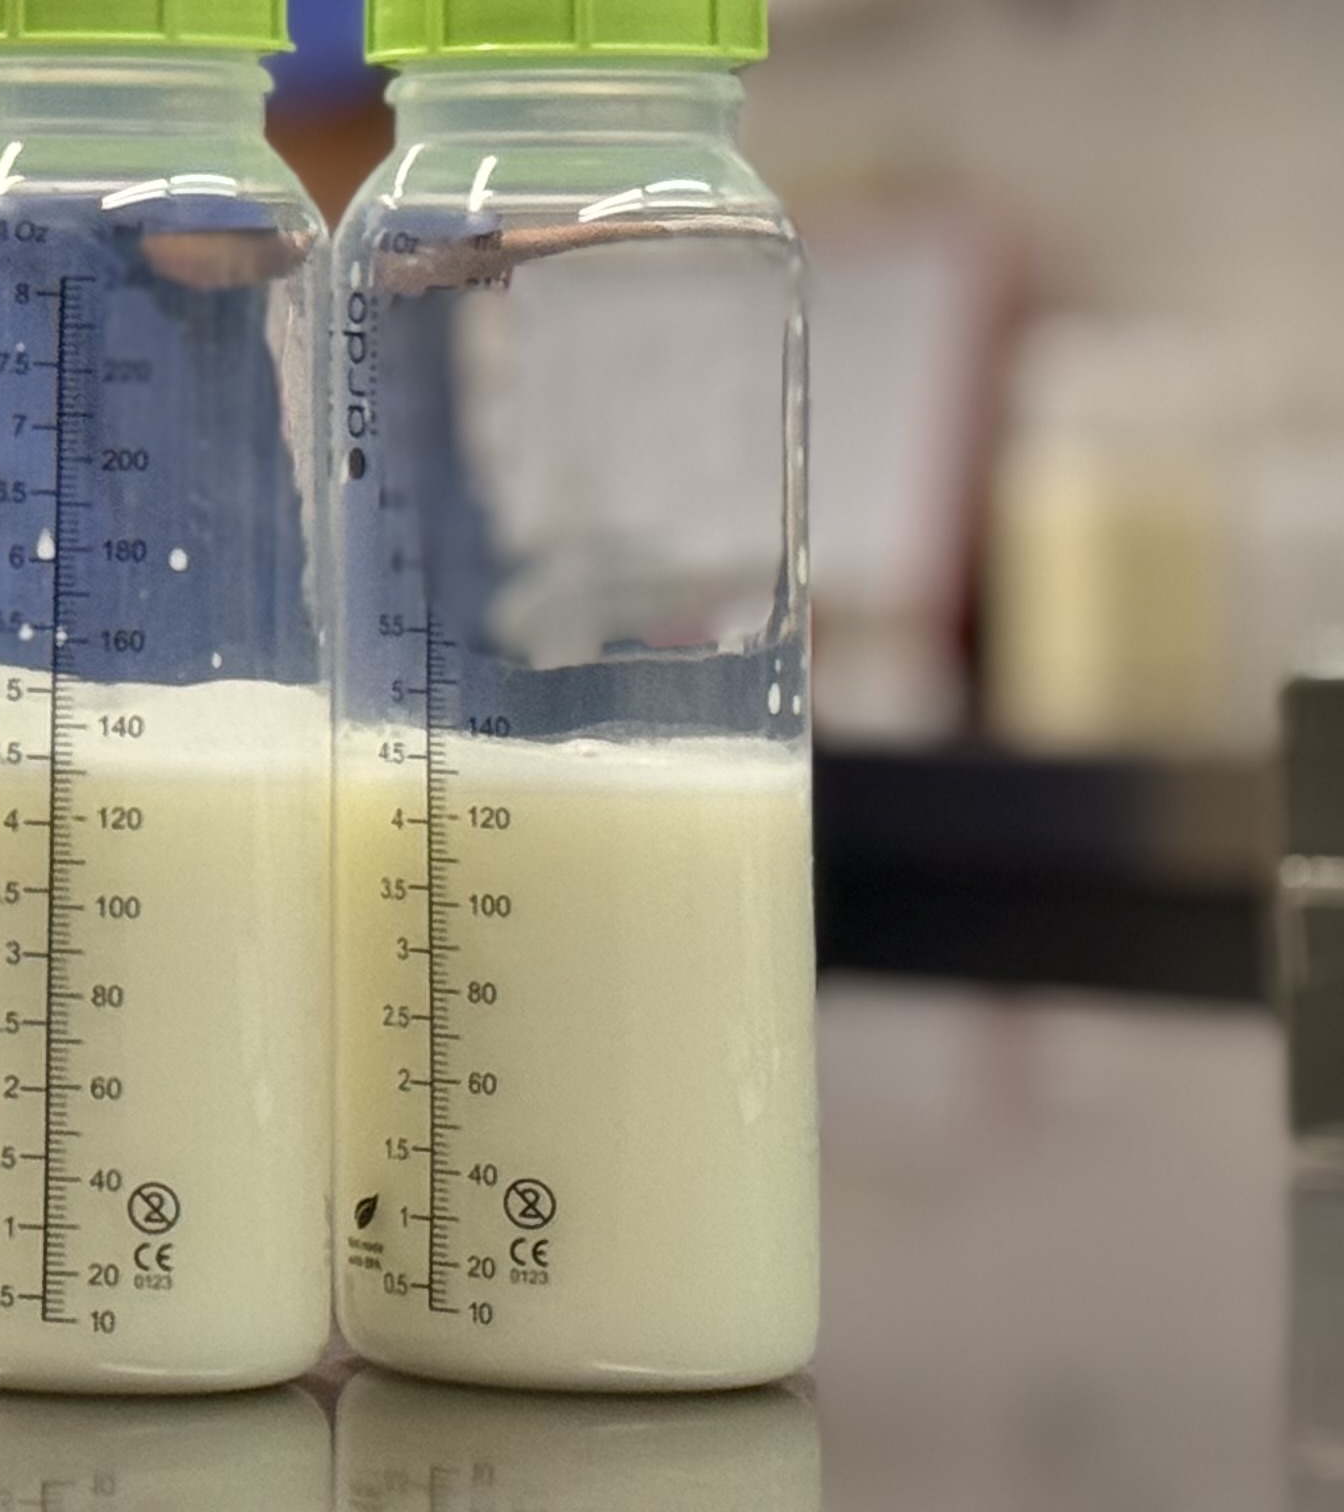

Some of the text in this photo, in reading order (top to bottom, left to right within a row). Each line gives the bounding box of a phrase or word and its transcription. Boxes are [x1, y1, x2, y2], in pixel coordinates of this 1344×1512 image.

[15, 220, 50, 243] Oz
[15, 282, 30, 305] 8
[342, 292, 368, 439] ardo
[11, 415, 27, 437] 7
[101, 449, 150, 472] 200
[8, 549, 24, 568] 6
[104, 541, 147, 563] 180
[100, 631, 145, 654] 160
[5, 679, 23, 700] 5
[392, 681, 404, 702] 5
[98, 715, 145, 738] 140
[468, 716, 511, 739] 140
[378, 743, 405, 764] 4.5
[3, 810, 19, 831] 4
[97, 807, 143, 831] 120
[391, 809, 405, 830] 4
[468, 807, 511, 830] 120
[381, 878, 406, 901] 3.5
[96, 896, 141, 920] 100
[469, 894, 511, 918] 100
[5, 942, 21, 965] 3
[396, 938, 409, 960] 3
[92, 986, 124, 1009] 80
[468, 982, 497, 1005] 80
[383, 1006, 410, 1029] 2.5
[3, 1076, 20, 1099] 2
[90, 1078, 123, 1100] 60
[398, 1069, 411, 1091] 2
[468, 1073, 497, 1095] 60
[385, 1138, 409, 1161] 1.5
[89, 1169, 122, 1192] 40
[468, 1164, 498, 1187] 40
[5, 1217, 15, 1238] 1
[399, 1206, 408, 1228] 1
[133, 1243, 173, 1272] CE
[510, 1238, 550, 1268] CE
[88, 1265, 120, 1287] 20
[467, 1256, 496, 1280] 20
[384, 1273, 408, 1296] 0.5
[90, 1311, 116, 1334] 10
[468, 1302, 493, 1326] 10
